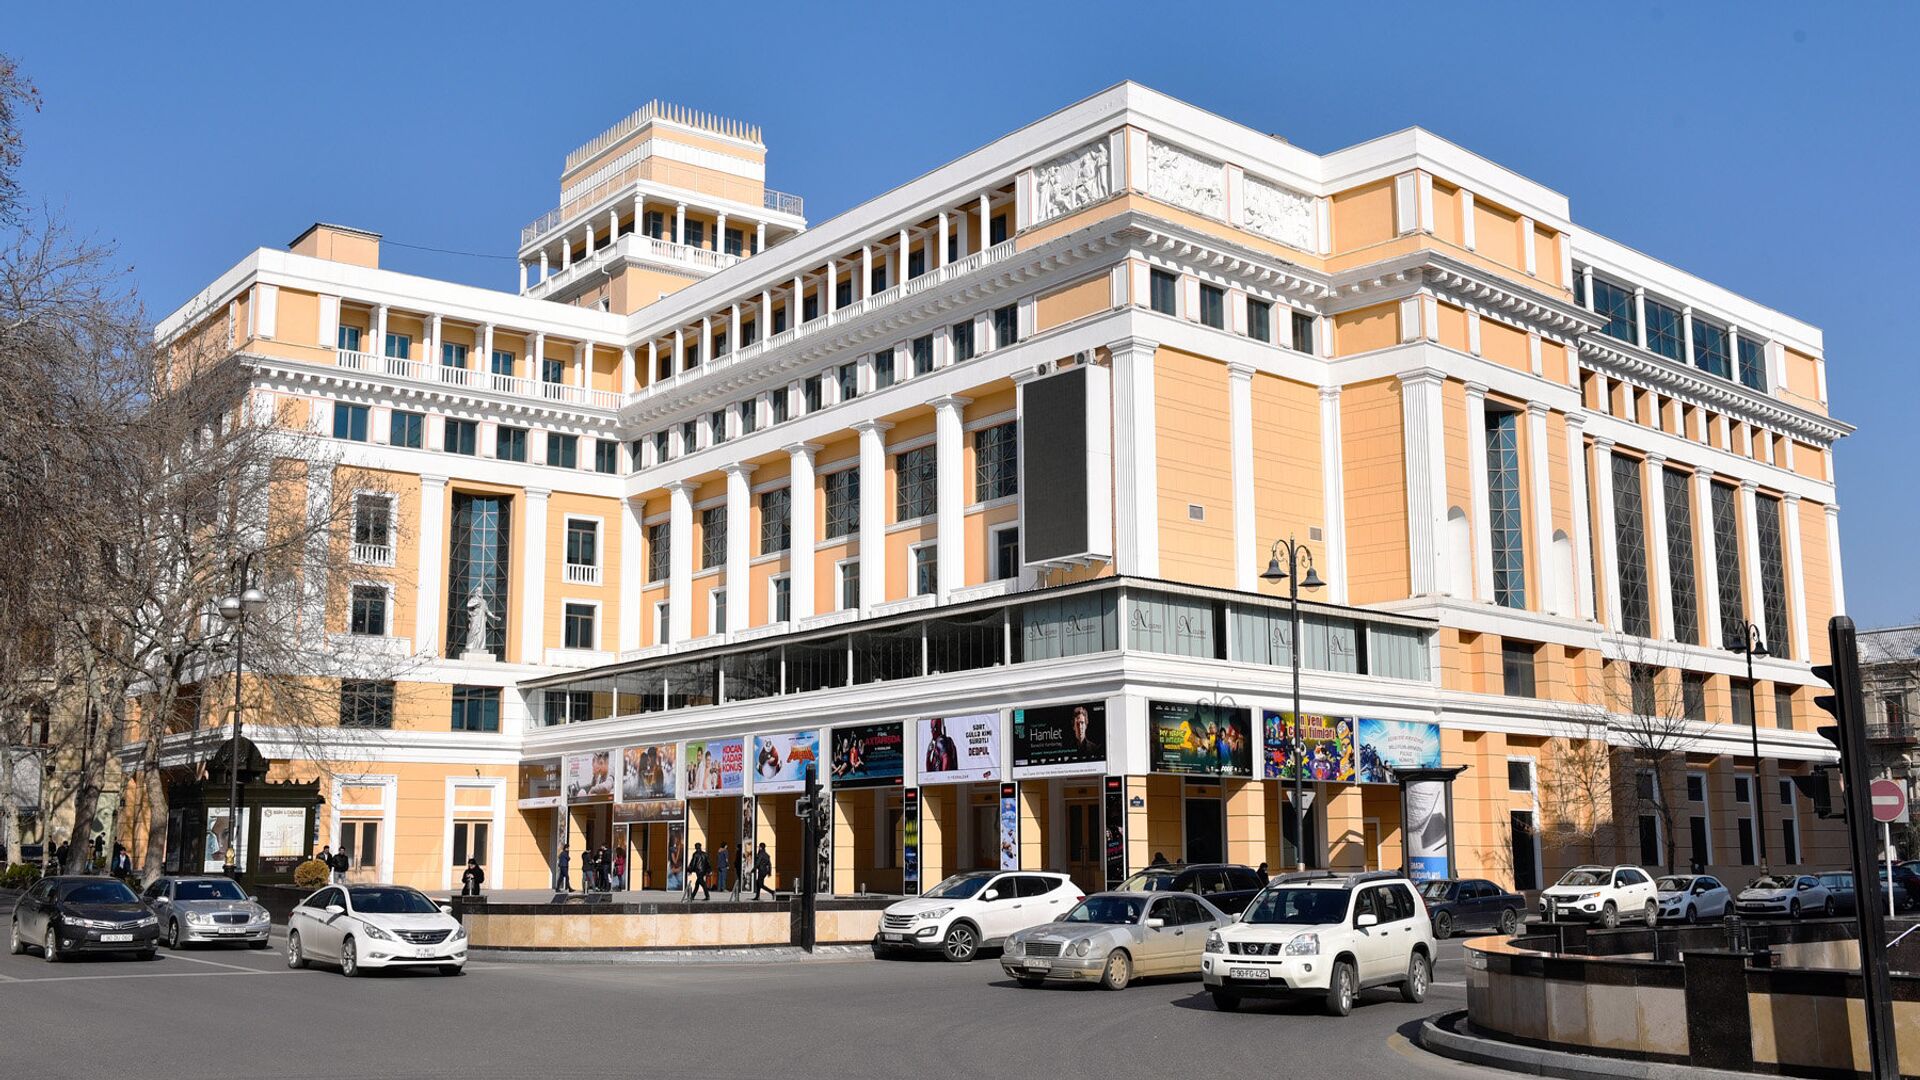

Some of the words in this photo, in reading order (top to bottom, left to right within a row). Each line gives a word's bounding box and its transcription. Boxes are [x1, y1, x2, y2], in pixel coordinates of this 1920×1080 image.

[1030, 726, 1063, 741] Hamlet
[722, 744, 743, 754] KOCAN
[722, 754, 743, 763] KADAR
